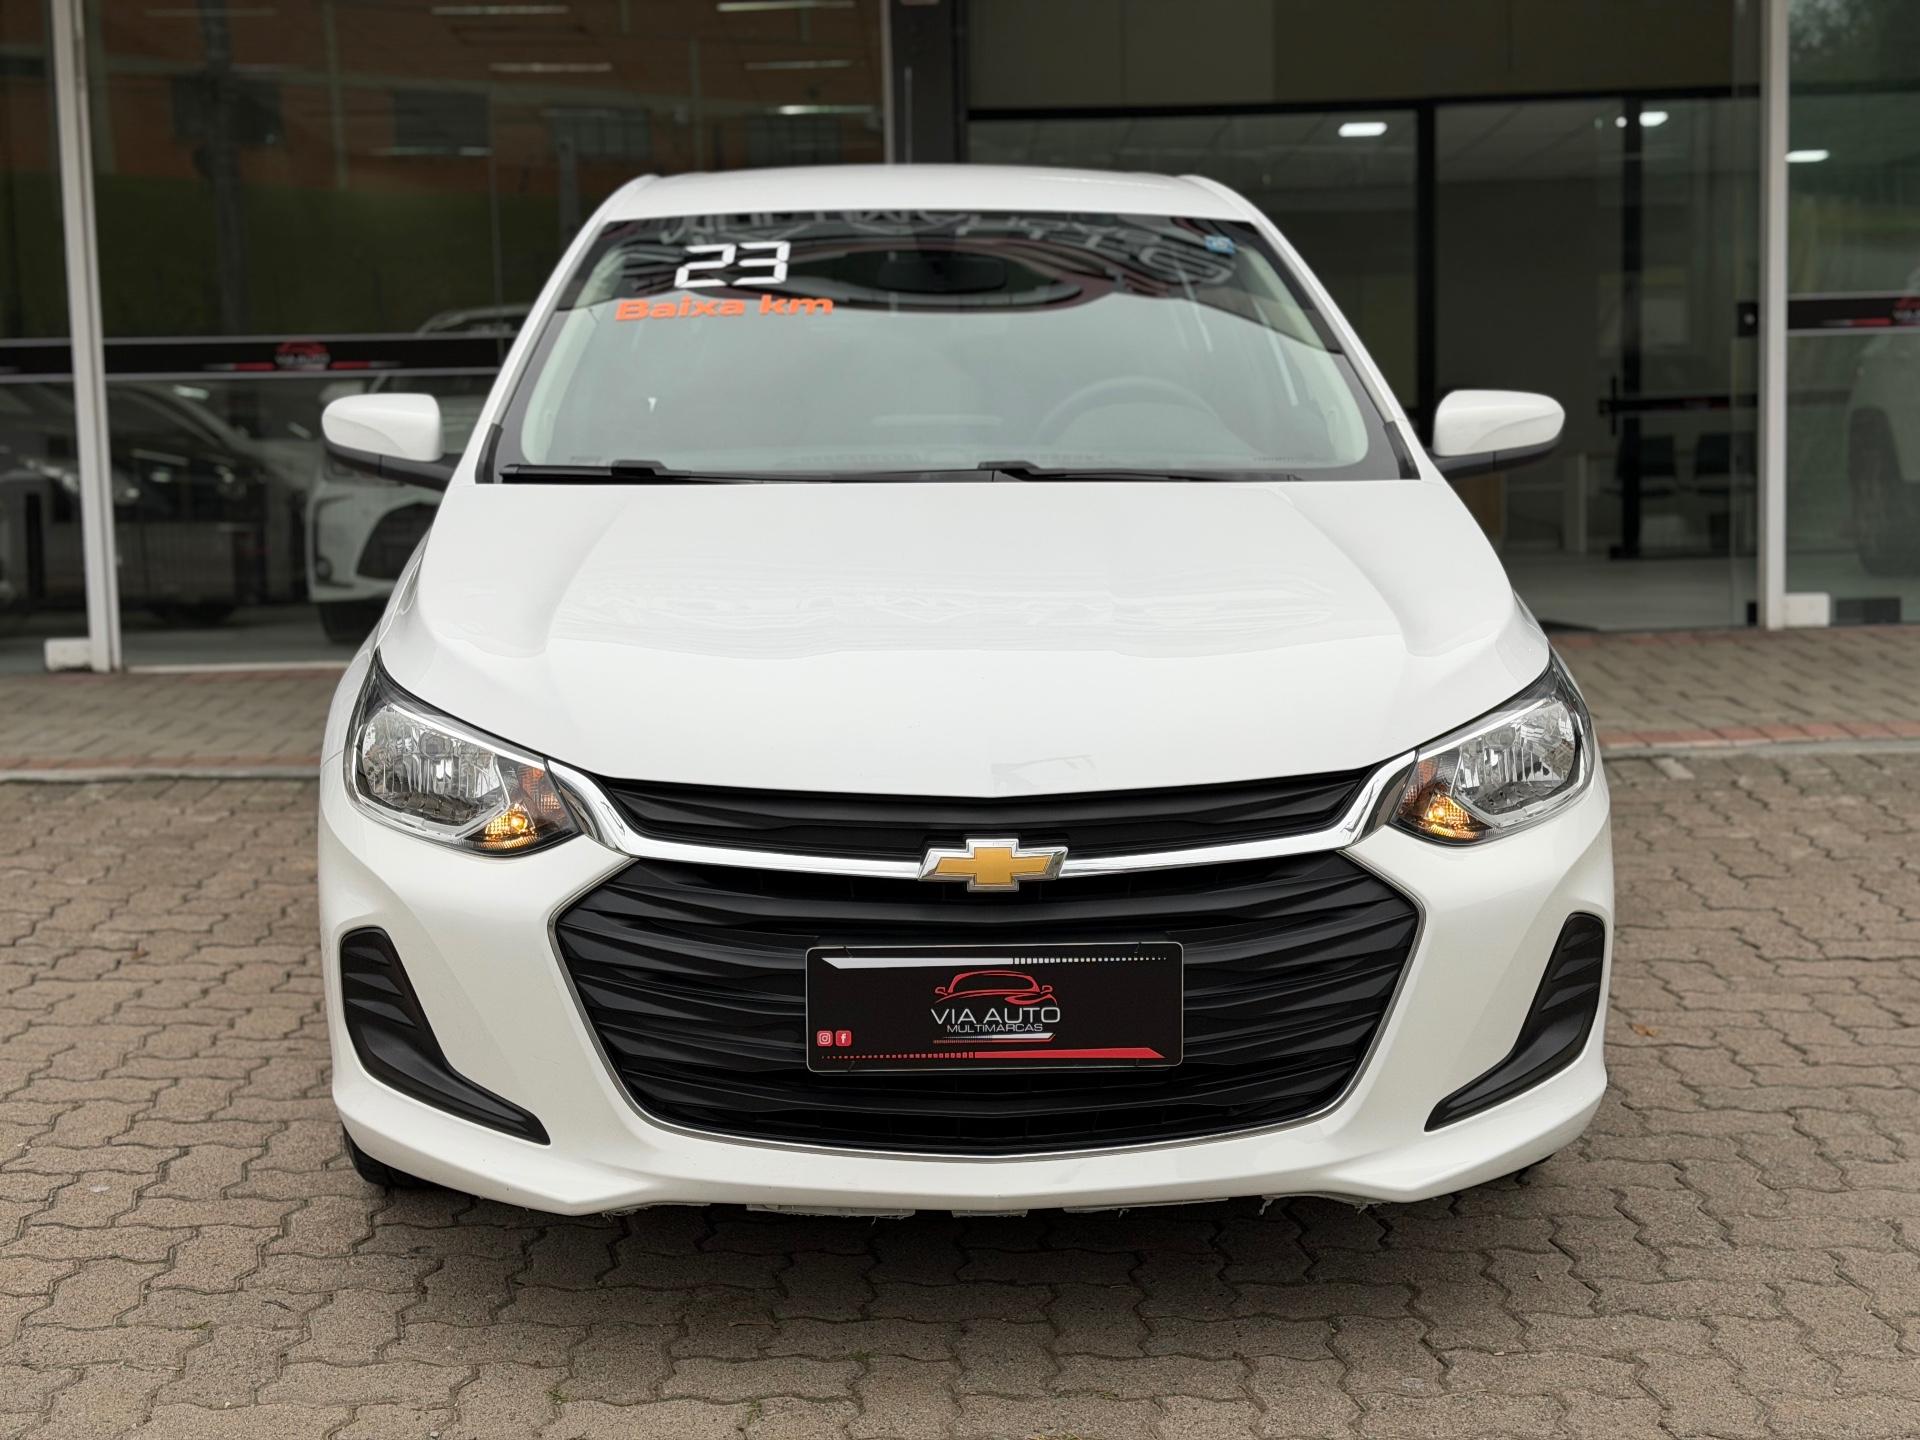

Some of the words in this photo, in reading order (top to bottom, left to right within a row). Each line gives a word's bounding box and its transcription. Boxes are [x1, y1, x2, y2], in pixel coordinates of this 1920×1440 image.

[675, 241, 791, 288] 23
[615, 296, 745, 321] Baixa
[759, 294, 834, 315] km
[931, 1008, 977, 1024] VIA
[983, 1007, 1060, 1024] AUTO
[947, 1024, 1043, 1033] MULTIMARCAS
